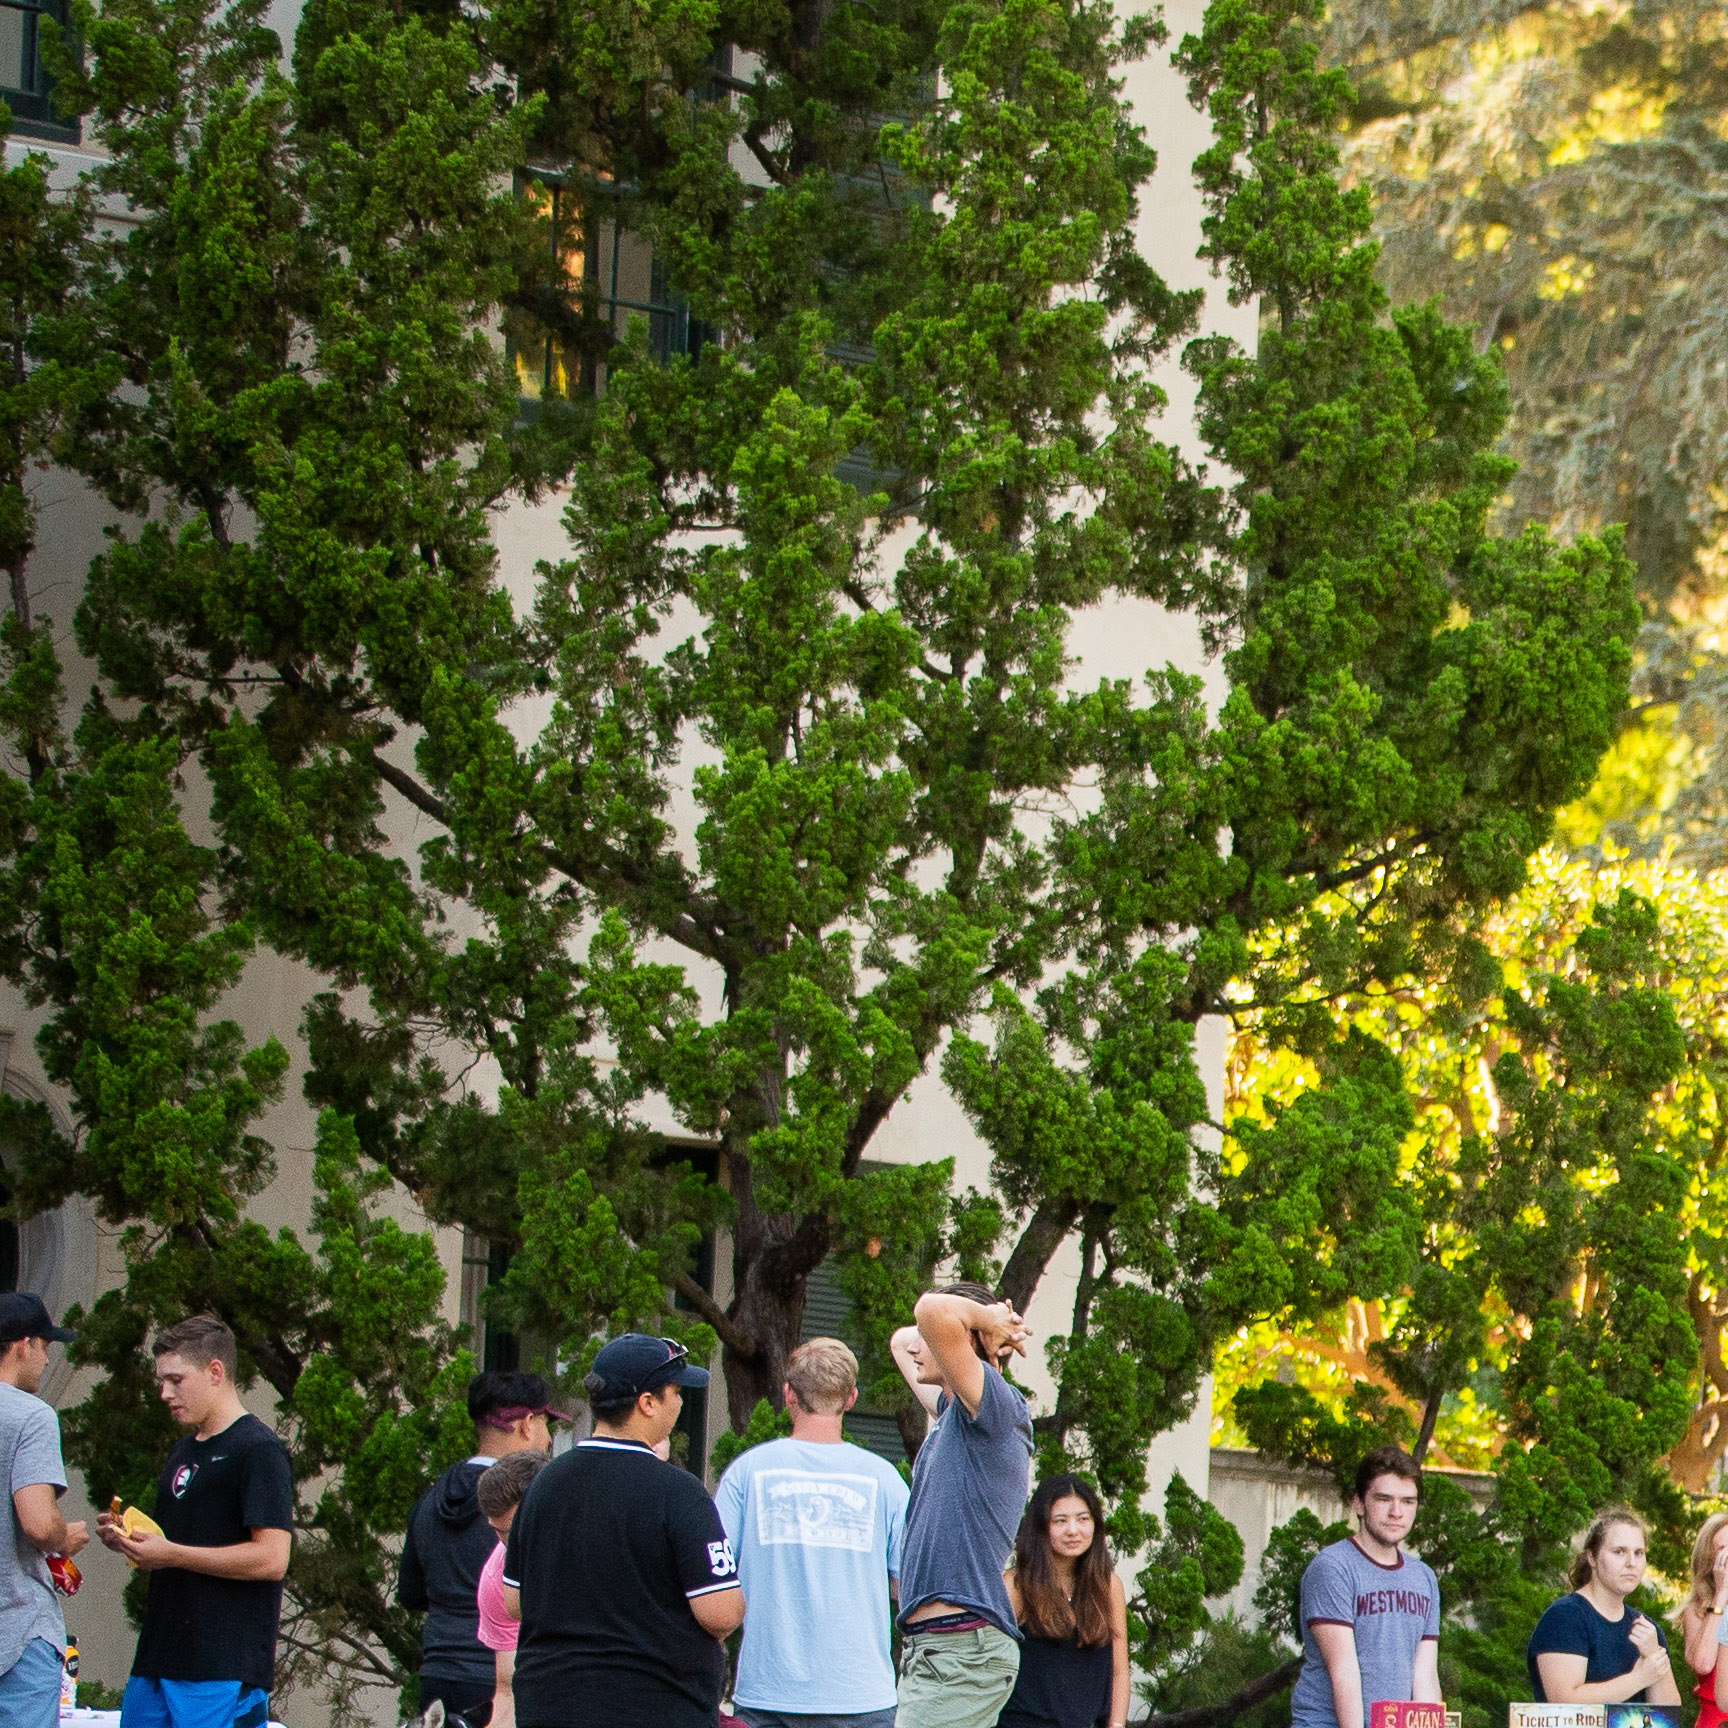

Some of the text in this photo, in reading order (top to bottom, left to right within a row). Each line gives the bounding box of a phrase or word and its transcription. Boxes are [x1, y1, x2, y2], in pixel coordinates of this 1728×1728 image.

[1356, 1590, 1430, 1620] WESTMONT
[1518, 1713, 1604, 1728] TICKET TO RIDE
